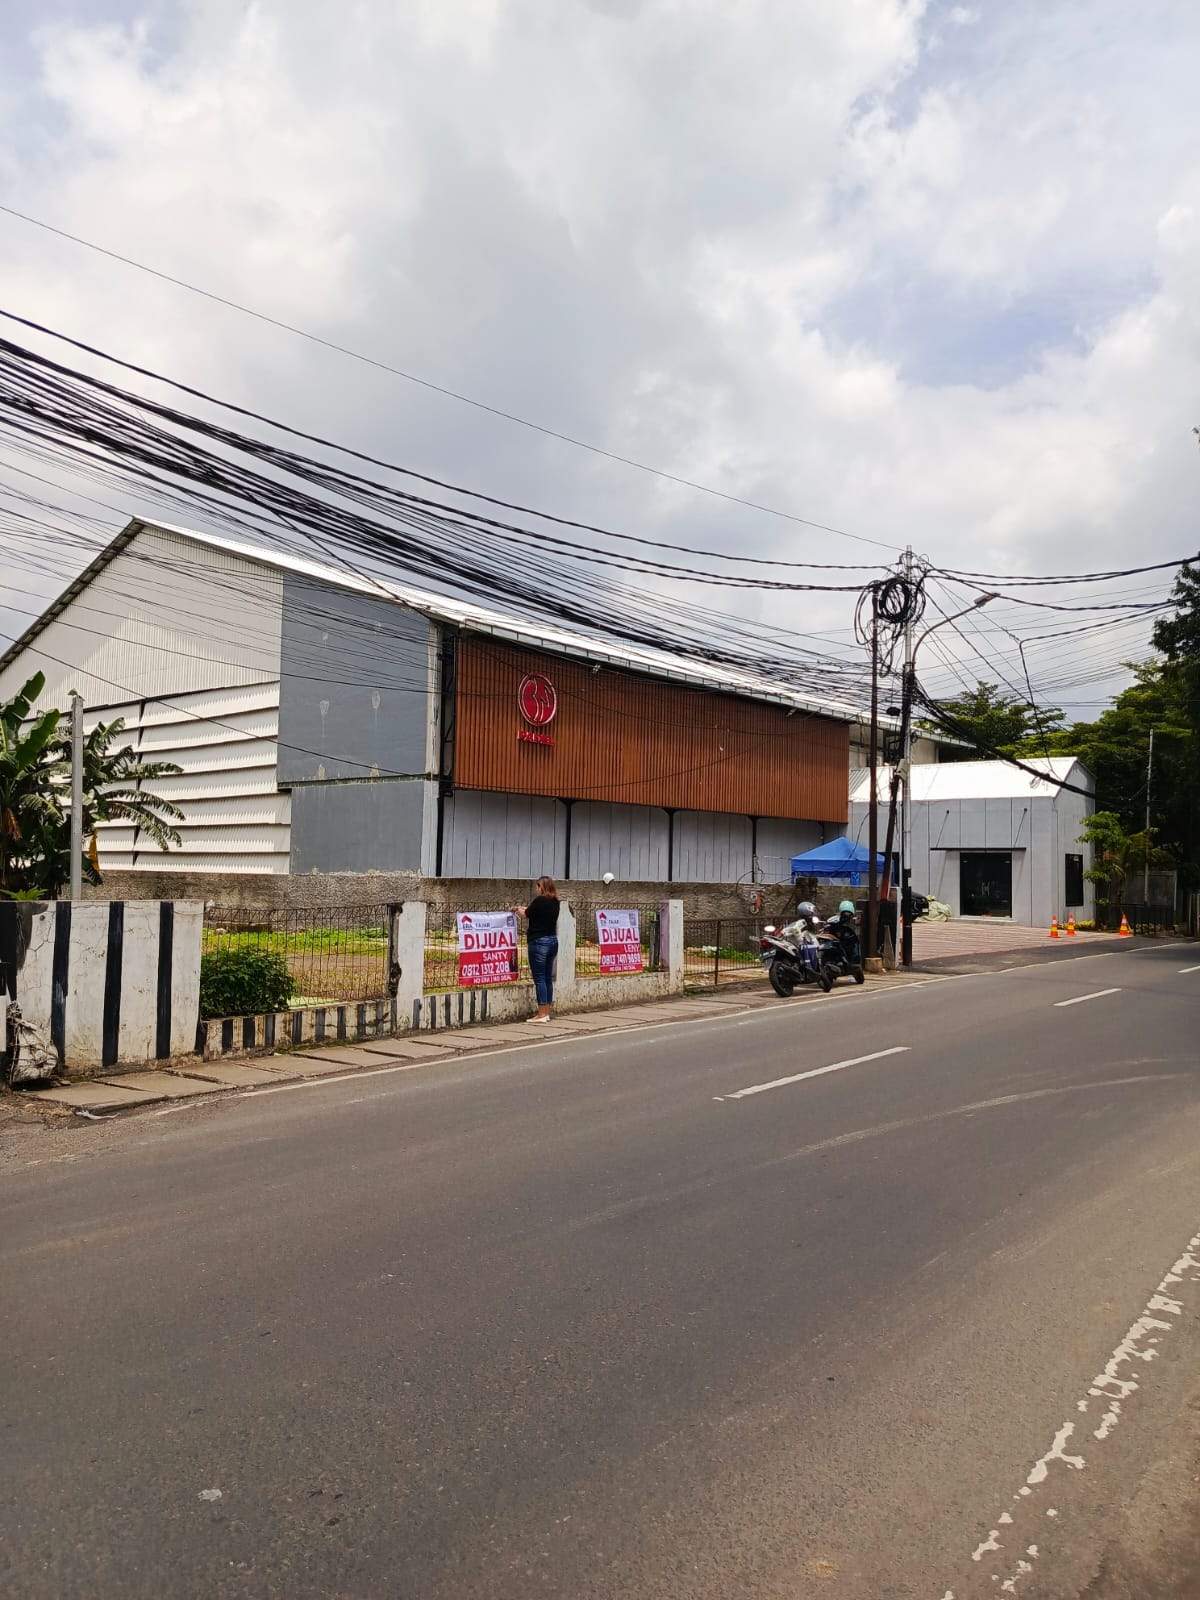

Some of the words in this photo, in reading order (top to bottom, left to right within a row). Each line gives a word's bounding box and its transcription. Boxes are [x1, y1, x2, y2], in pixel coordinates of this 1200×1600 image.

[464, 931, 516, 950] DIJUAL
[602, 928, 638, 942] DIJUAL
[482, 952, 508, 962] SANTY
[462, 964, 480, 976] 0812
